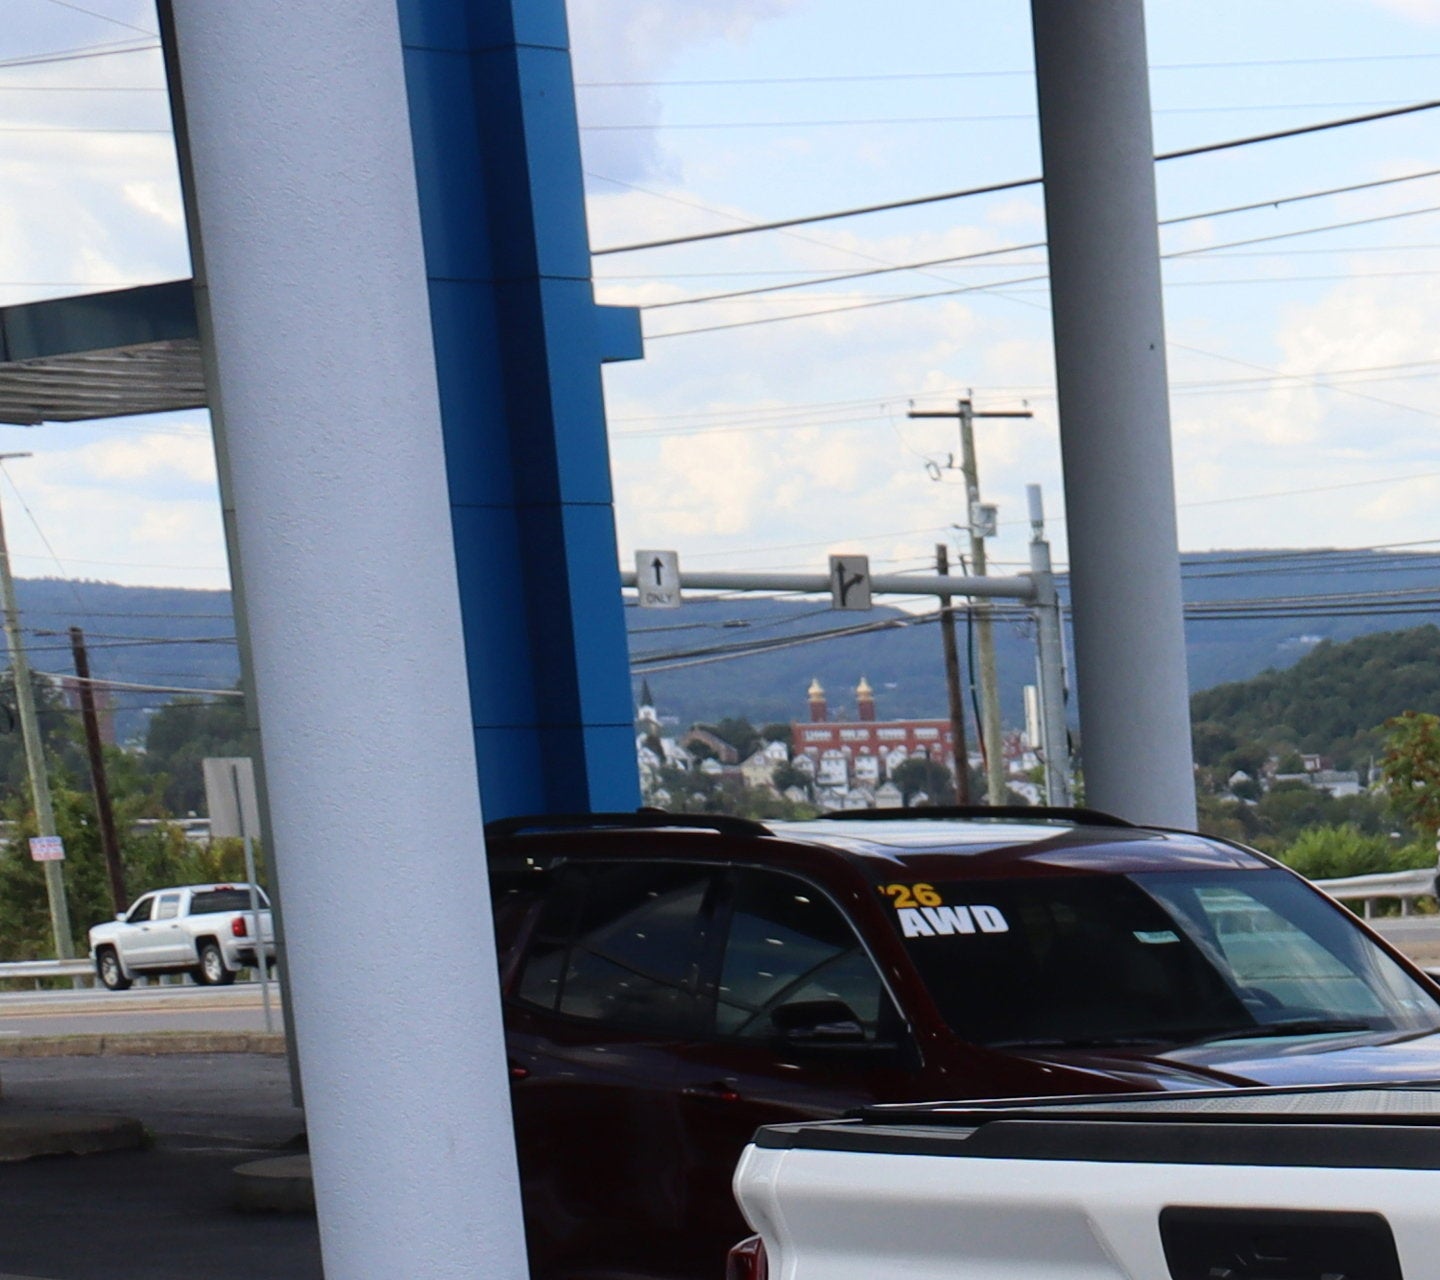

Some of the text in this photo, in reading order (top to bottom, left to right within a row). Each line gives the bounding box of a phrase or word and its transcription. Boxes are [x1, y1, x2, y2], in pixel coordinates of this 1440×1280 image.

[646, 592, 672, 605] ONLY
[878, 883, 943, 909] '26
[896, 904, 1010, 938] AWD
